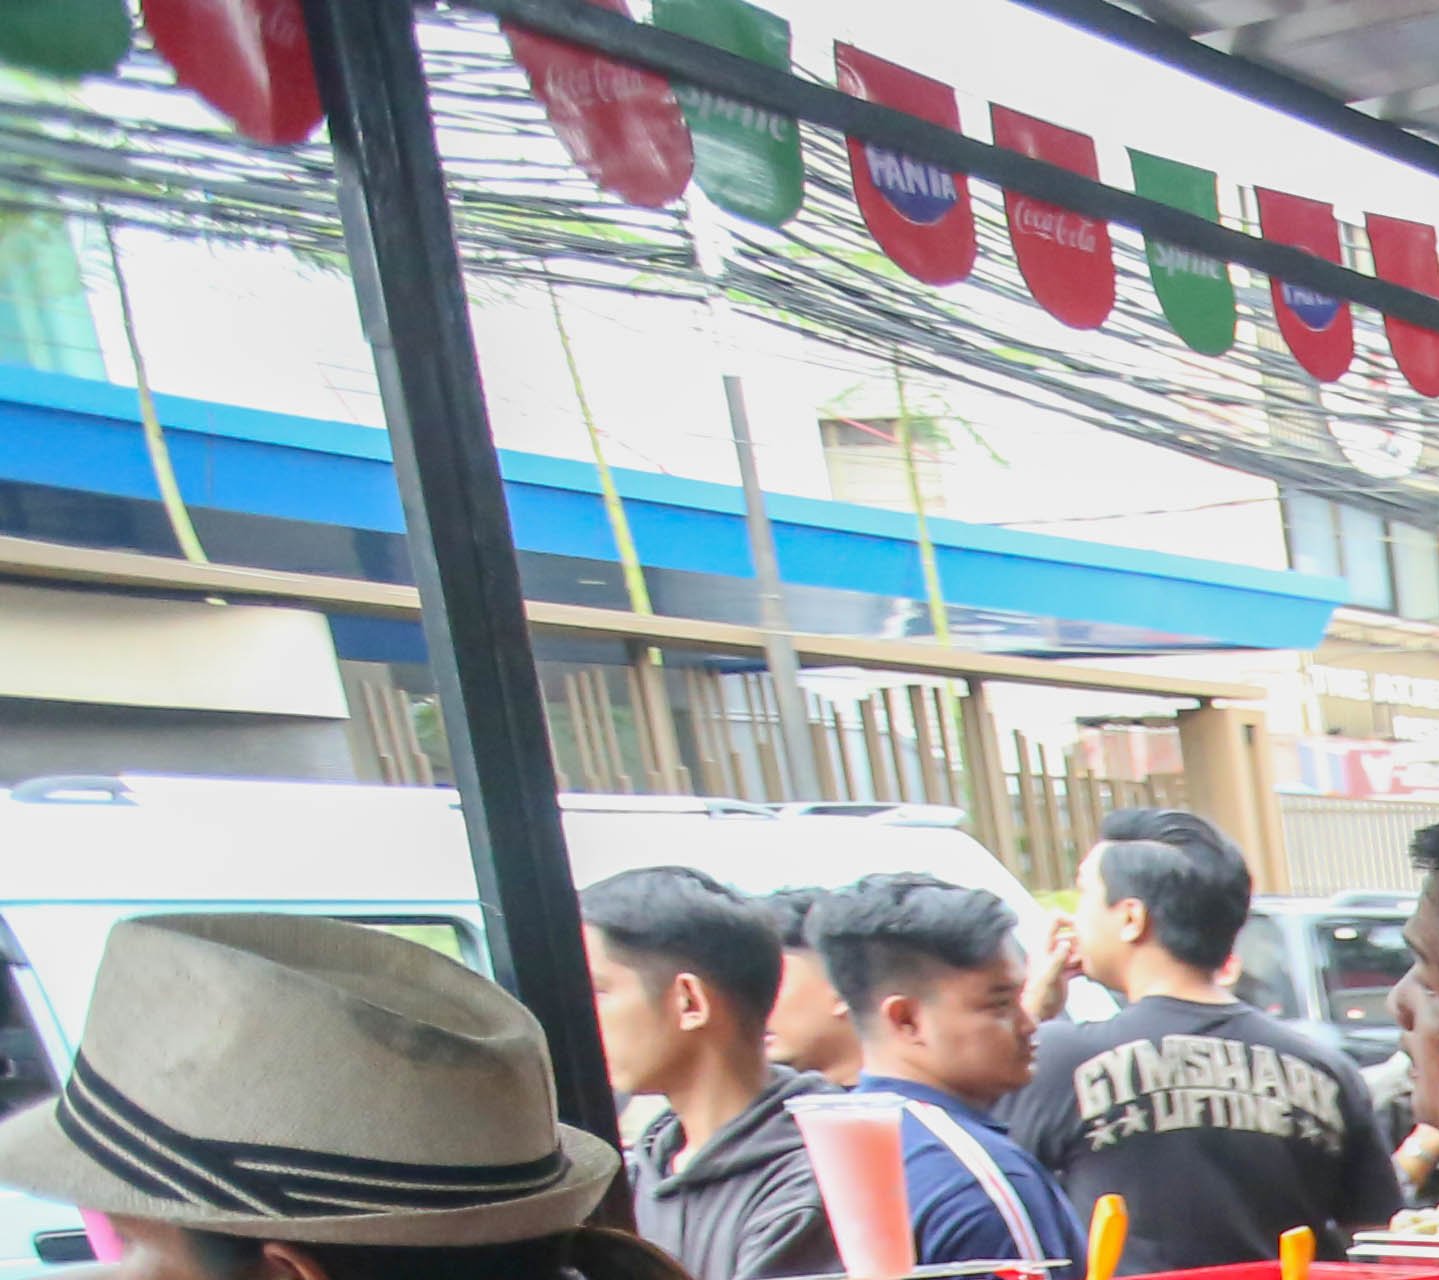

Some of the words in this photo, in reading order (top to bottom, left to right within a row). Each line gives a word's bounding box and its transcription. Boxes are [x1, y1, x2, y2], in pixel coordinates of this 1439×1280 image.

[1014, 199, 1098, 254] Coca-Cola
[1074, 1034, 1345, 1135] GYMSHARK
[1151, 1088, 1295, 1137] LIFTING
